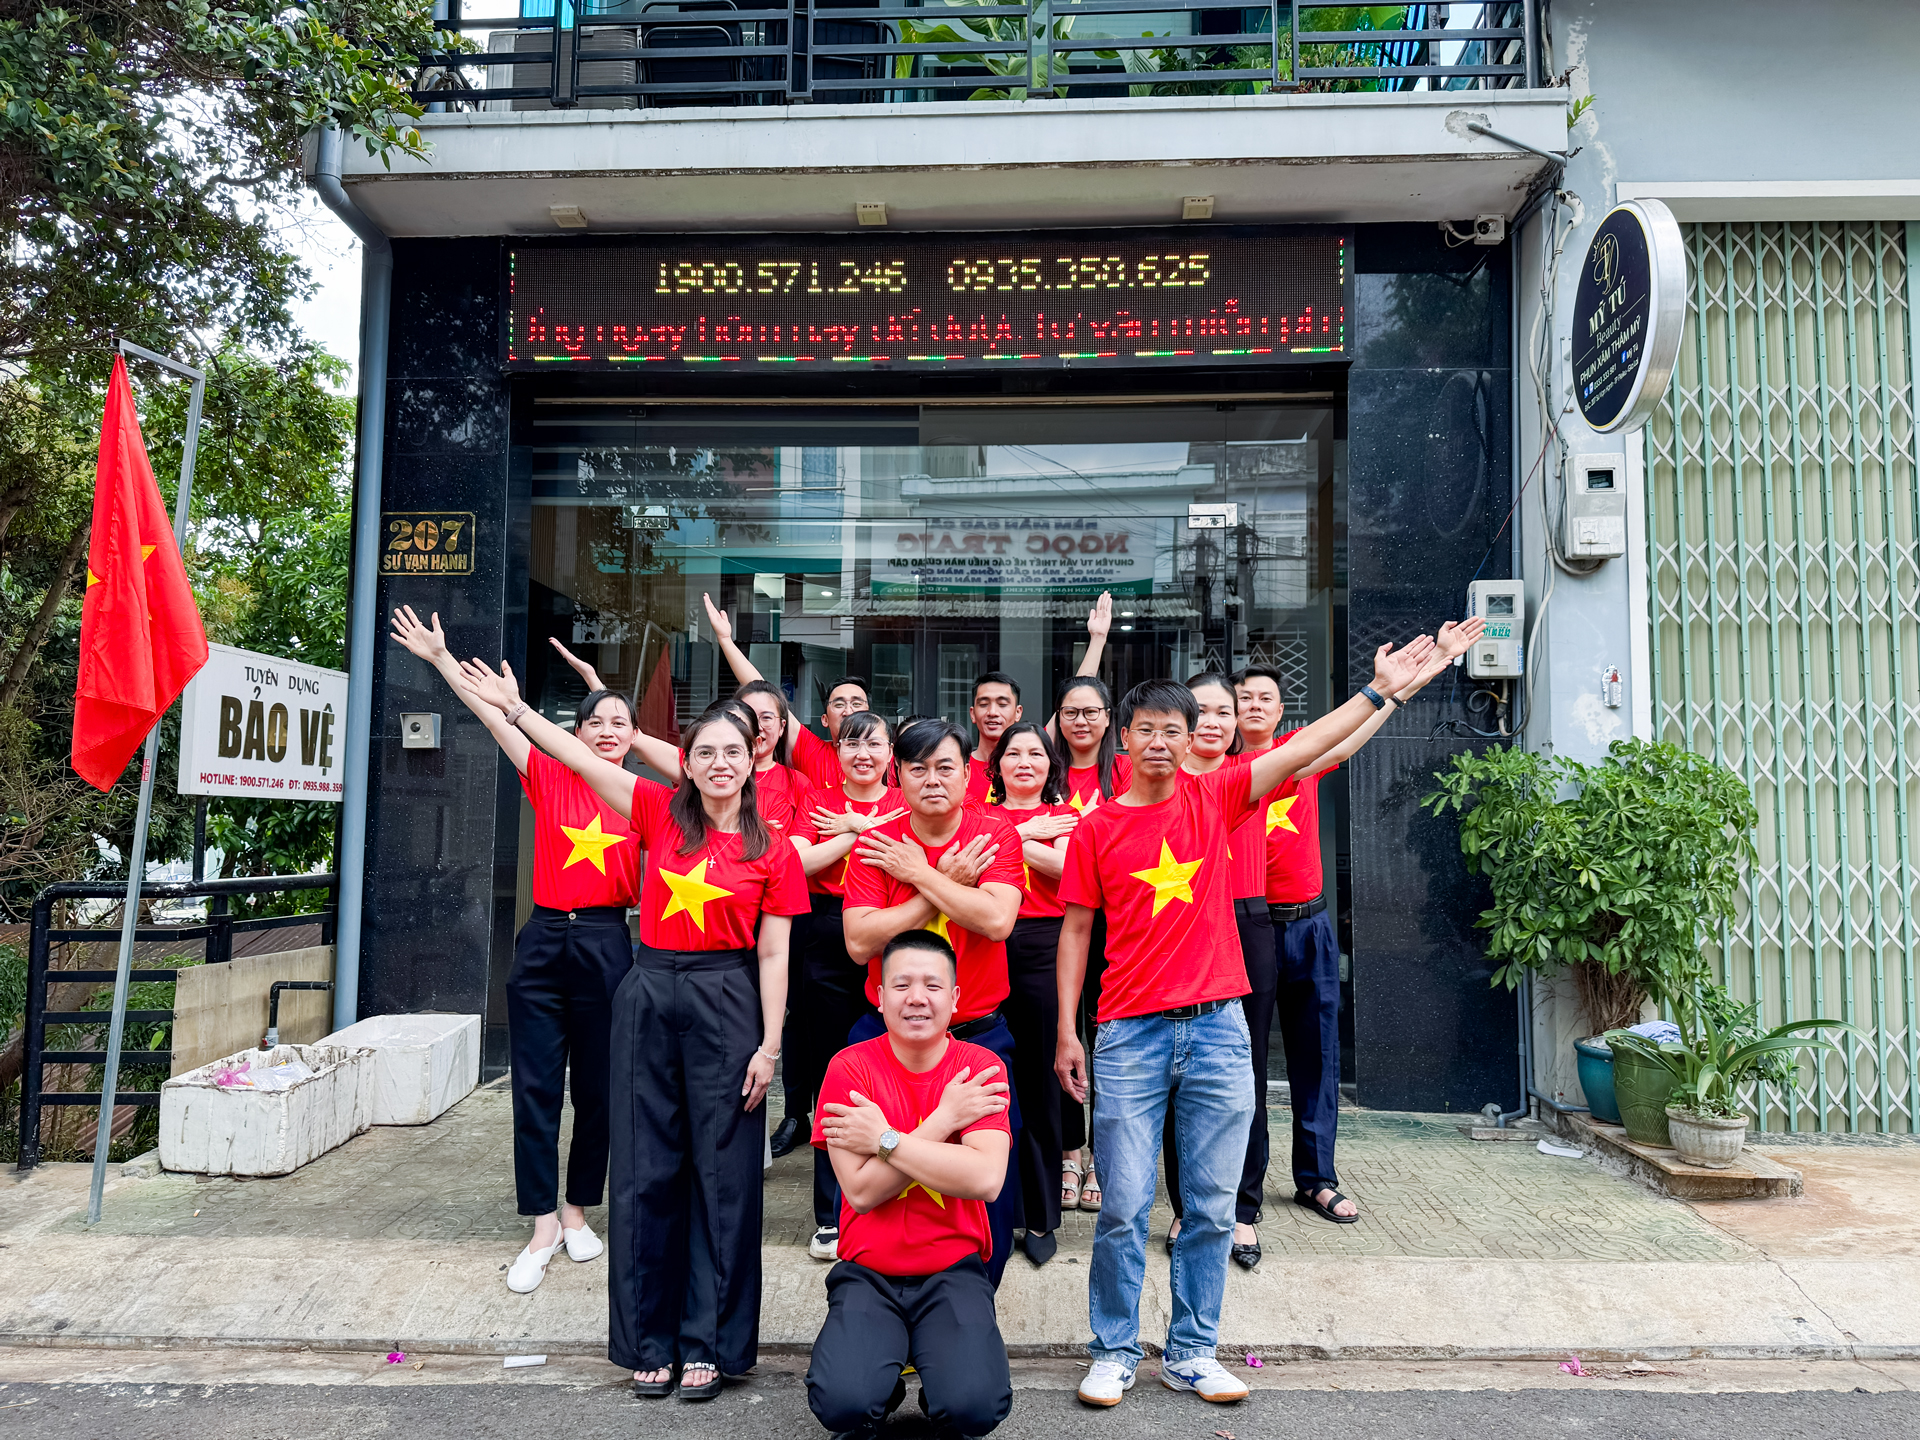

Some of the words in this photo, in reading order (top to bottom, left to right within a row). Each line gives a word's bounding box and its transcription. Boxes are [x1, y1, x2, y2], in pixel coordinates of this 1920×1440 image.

[655, 261, 907, 293] 1900.571.246
[948, 254, 1210, 290] 0935.350.625
[1588, 300, 1606, 338] MỸ
[1608, 275, 1627, 314] TÚ
[1596, 315, 1622, 349] Beauty
[1580, 361, 1597, 386] PHUN
[388, 519, 465, 552] 207
[383, 551, 403, 570] SƯ
[404, 554, 429, 573] VẠN
[430, 554, 467, 573] HẠNH
[244, 666, 278, 687] TUYỂN
[288, 676, 319, 695] DỤNG
[218, 686, 289, 763] BẢO
[299, 703, 335, 776] VỆ
[200, 772, 238, 786] HOTLINE:
[239, 775, 284, 789] 1900.571.246
[288, 779, 301, 790] ĐT:
[302, 781, 343, 793] 0935.988.359
